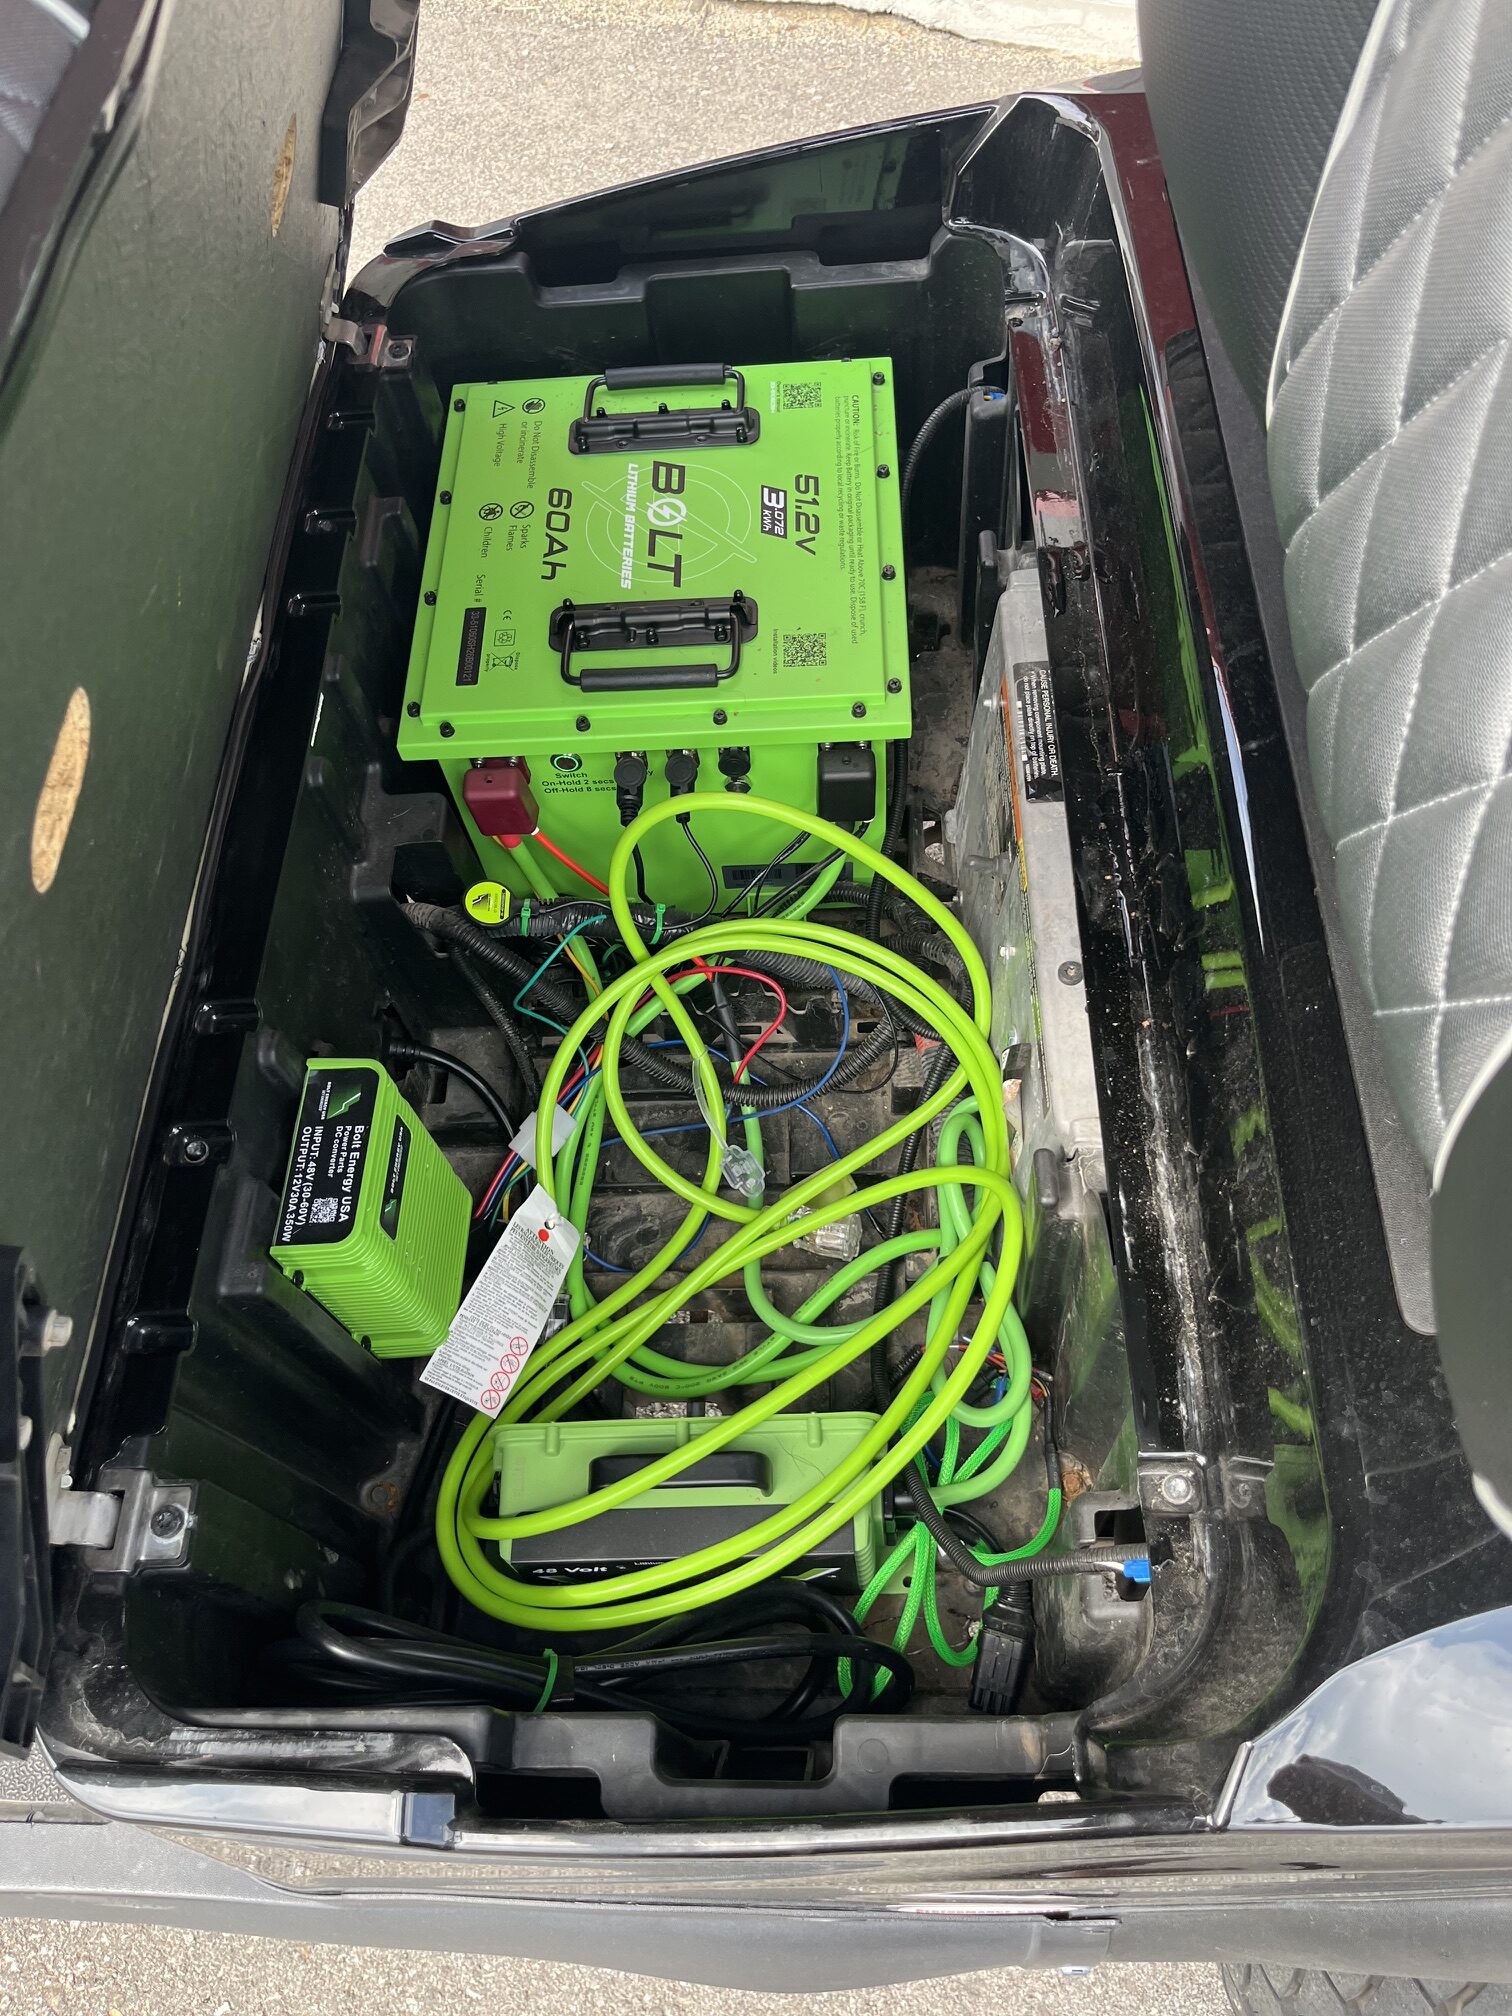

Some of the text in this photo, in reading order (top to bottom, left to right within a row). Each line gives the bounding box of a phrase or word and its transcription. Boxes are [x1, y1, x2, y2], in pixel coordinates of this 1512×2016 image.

[852, 395, 860, 426] CAUTION:
[493, 424, 507, 467] High Voltage
[517, 430, 528, 464] incinerate
[527, 421, 542, 488] Do Not Disassemble
[845, 468, 853, 486] Battery
[854, 482, 862, 490] Do
[846, 493, 854, 514] original
[620, 463, 638, 589] LITHIUM BATTERIES
[646, 461, 688, 588] BOLT
[762, 510, 772, 531] kWh
[480, 526, 492, 558] Children
[506, 525, 516, 551] Flames
[520, 524, 530, 549] Sparks
[541, 488, 572, 580] 60Ah
[474, 574, 486, 596] Serial
[849, 597, 857, 620] Dispose
[1030, 675, 1038, 689] When
[1039, 670, 1049, 689] CAUSE
[1024, 691, 1032, 704] place
[1031, 690, 1041, 711] removing
[1040, 690, 1052, 722] PERSONAL
[1025, 705, 1034, 716] plate
[1026, 717, 1036, 734] directly
[1033, 712, 1043, 738] component
[1045, 722, 1054, 743] INJURY
[1036, 739, 1045, 761] mounting
[1048, 744, 1056, 754] OR
[1049, 755, 1058, 777] DEATH.
[309, 1126, 323, 1160] INPUT:
[328, 1126, 343, 1178] DC converter
[337, 1126, 352, 1173] Power Parts
[305, 1161, 317, 1180] 48V
[338, 1125, 365, 1222] Bolt Energy USA
[282, 1126, 312, 1242] OUTPUT: 12V30A 350W
[295, 1182, 313, 1225] (30-60V)
